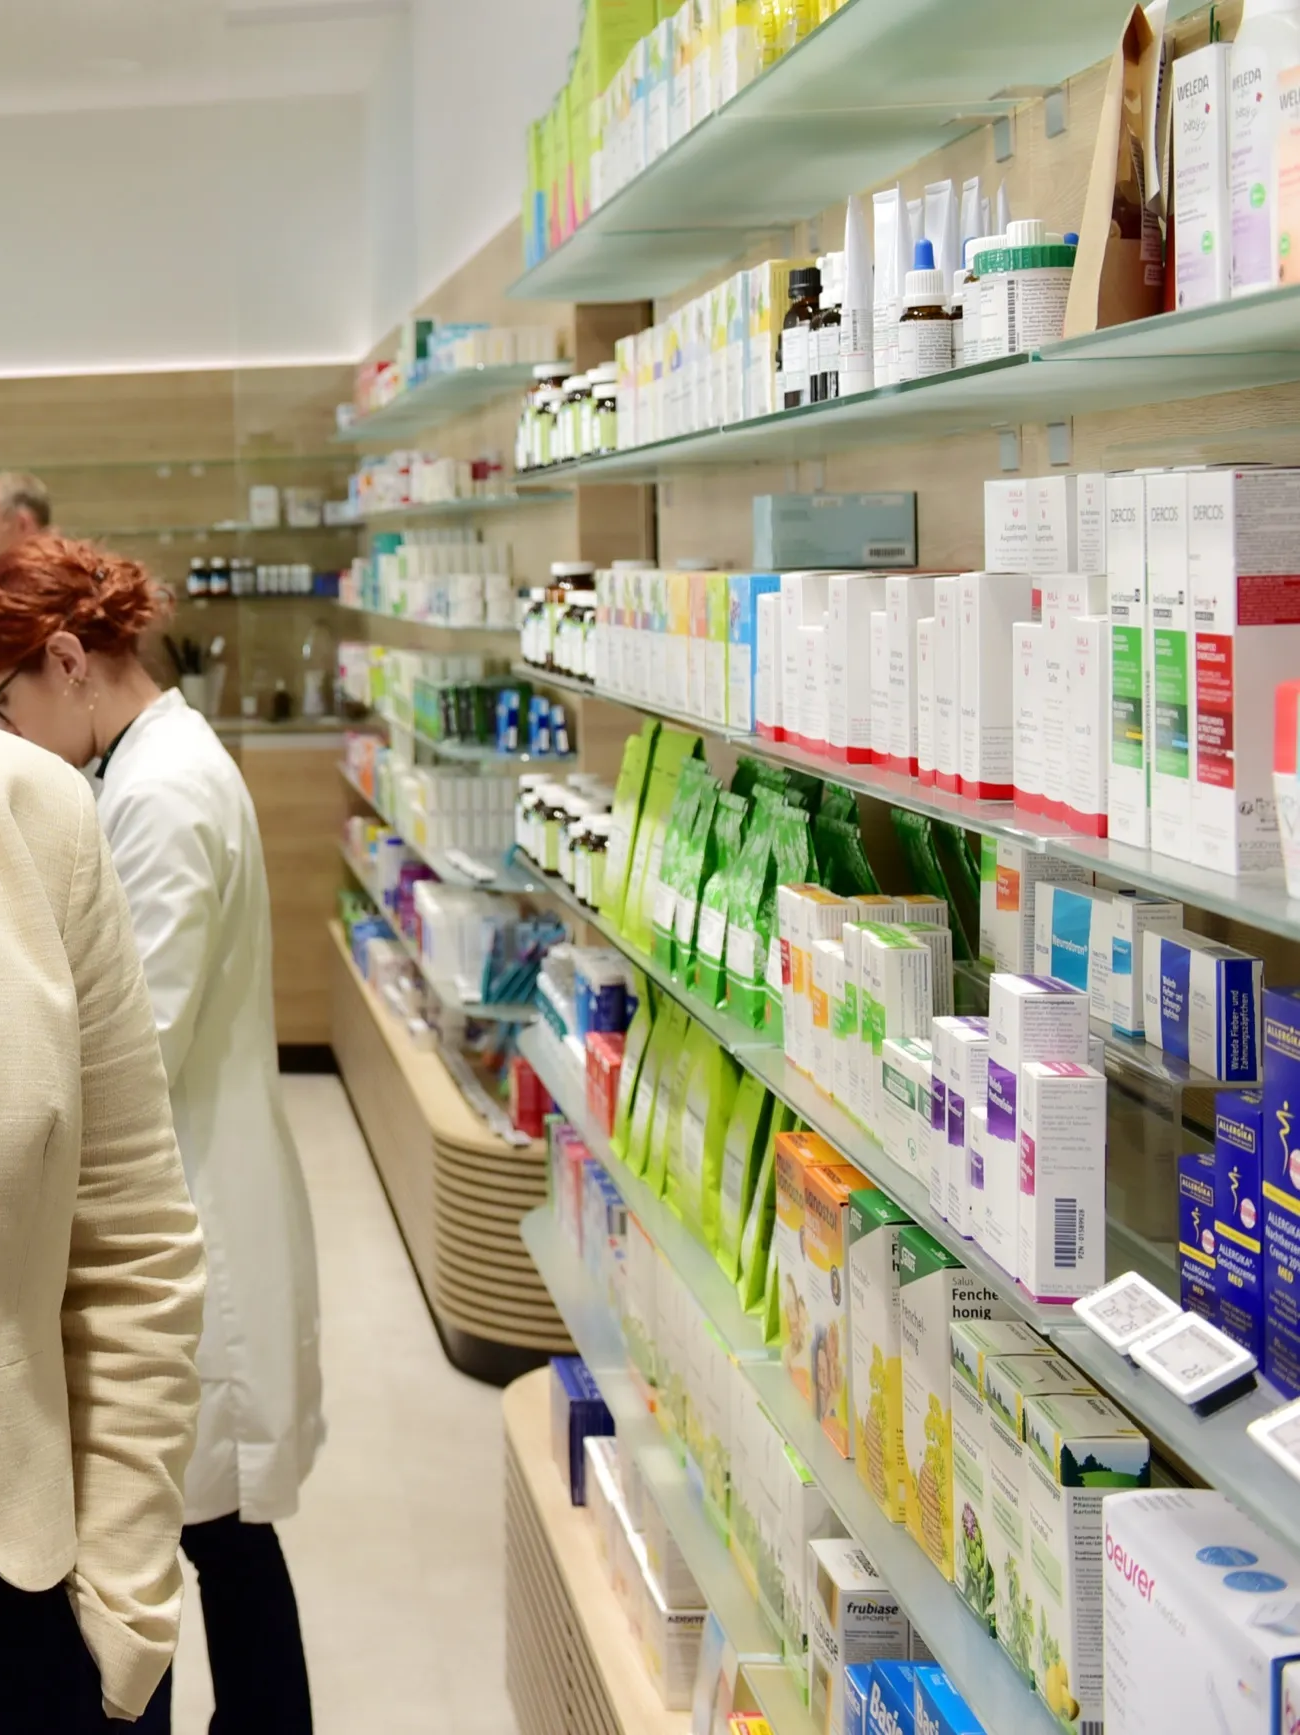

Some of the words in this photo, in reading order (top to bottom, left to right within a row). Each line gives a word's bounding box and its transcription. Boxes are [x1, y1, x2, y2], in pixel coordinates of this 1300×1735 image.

[1177, 74, 1209, 102] WELEDA
[1232, 67, 1262, 92] WELEDA
[1111, 507, 1136, 523] DERCOS
[1151, 506, 1179, 522] DERCOS
[1193, 504, 1224, 521] DERCOS
[1230, 989, 1240, 1006] und
[1230, 1007, 1240, 1037] Fieber-
[1239, 992, 1251, 1071] Zahnungszäpfchen
[1230, 1038, 1240, 1071] Weleda
[1218, 1120, 1253, 1142] ALLERGIKA
[1182, 1176, 1212, 1197] ALLERGIKA
[1078, 1245, 1086, 1260] PZN
[1269, 1243, 1288, 1265] Creme
[1216, 1254, 1257, 1284] Gesichtscreme
[1277, 1264, 1294, 1284] MED
[952, 1276, 974, 1287] Salus
[1227, 1271, 1244, 1288] MED
[952, 1287, 1000, 1301] Fenche
[1192, 1284, 1205, 1296] MED
[901, 1298, 928, 1336] Fenchel-
[952, 1304, 992, 1320] honig
[1105, 1521, 1155, 1604] beurer
[846, 1601, 899, 1615] frubiase
